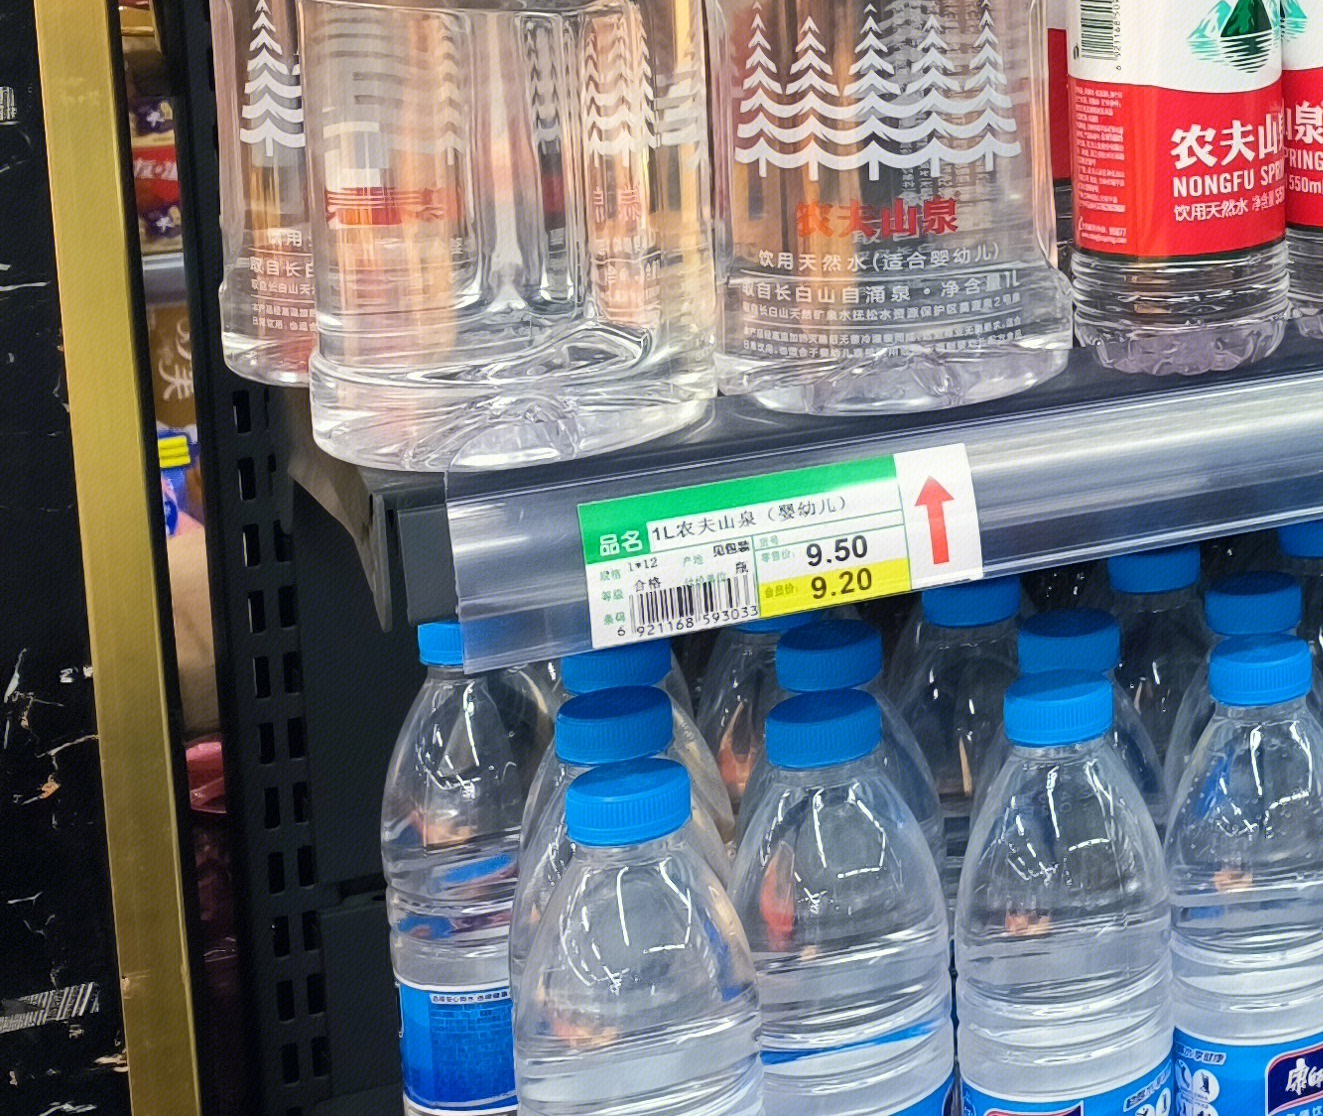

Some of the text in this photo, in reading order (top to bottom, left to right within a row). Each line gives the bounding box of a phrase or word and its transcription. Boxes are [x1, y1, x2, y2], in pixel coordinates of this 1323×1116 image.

[1173, 169, 1254, 198] NONGFU
[795, 196, 958, 238] 农夫山泉
[1174, 197, 1248, 221] 饮用天然水
[598, 530, 644, 557] 品名
[634, 576, 662, 593] 合格
[806, 534, 868, 567] 9.50
[811, 567, 872, 600] 9.20
[616, 605, 759, 638] 6 921168 593033
